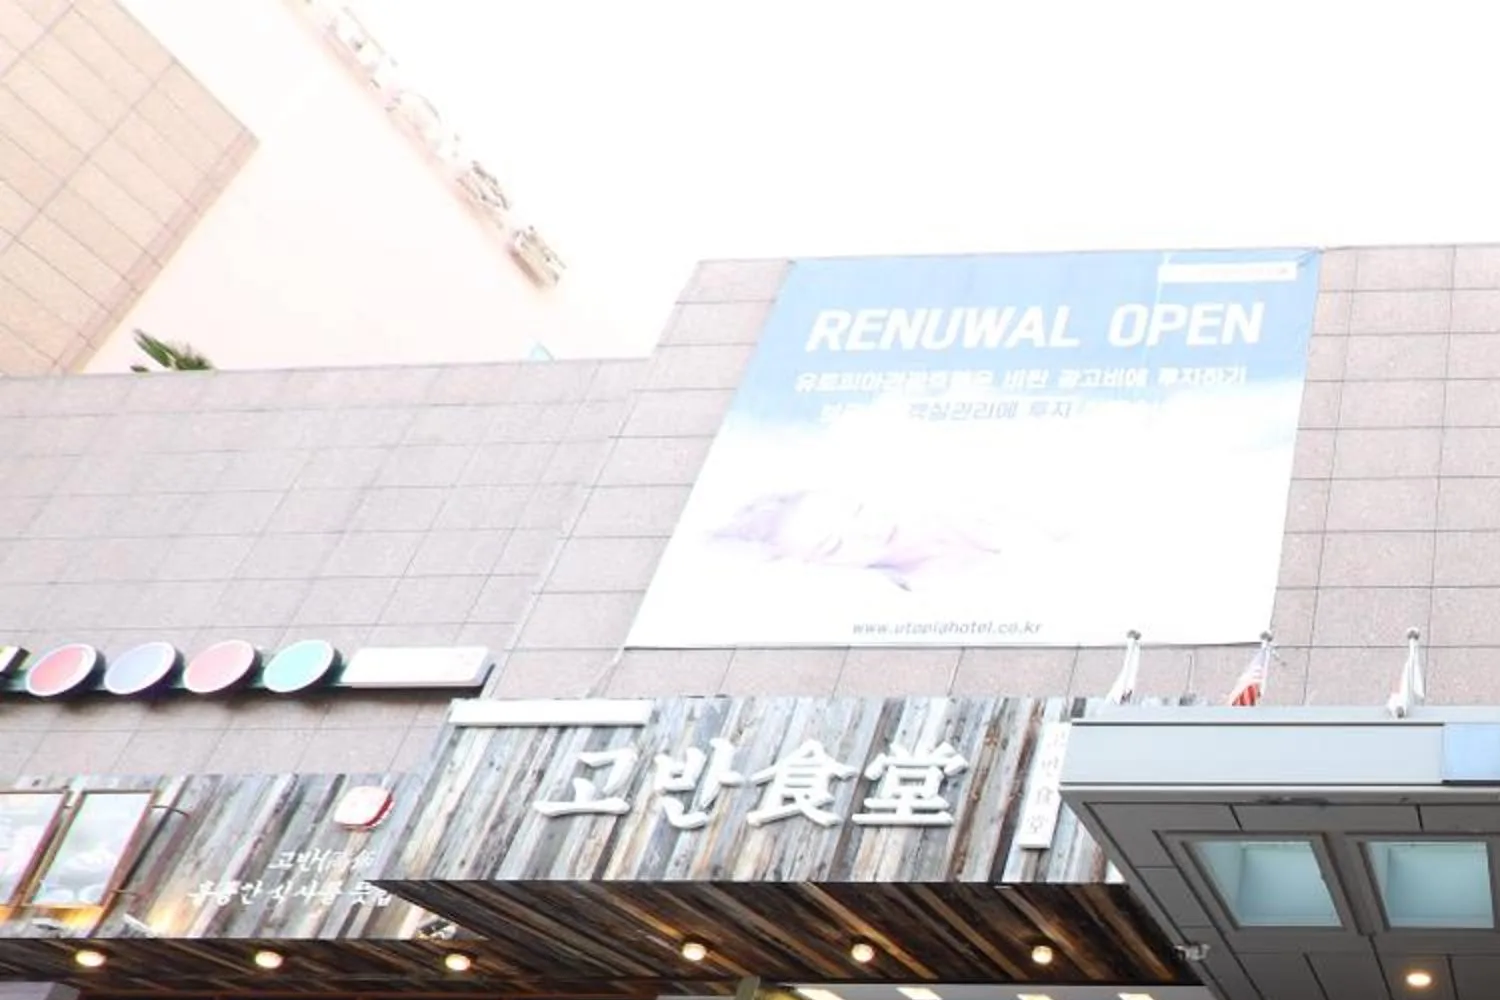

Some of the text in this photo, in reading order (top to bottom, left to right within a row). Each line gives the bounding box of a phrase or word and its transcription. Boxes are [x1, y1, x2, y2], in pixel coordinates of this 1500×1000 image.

[803, 301, 1265, 351] RENUWAL OPEN
[534, 736, 969, 829] 고반食堂
